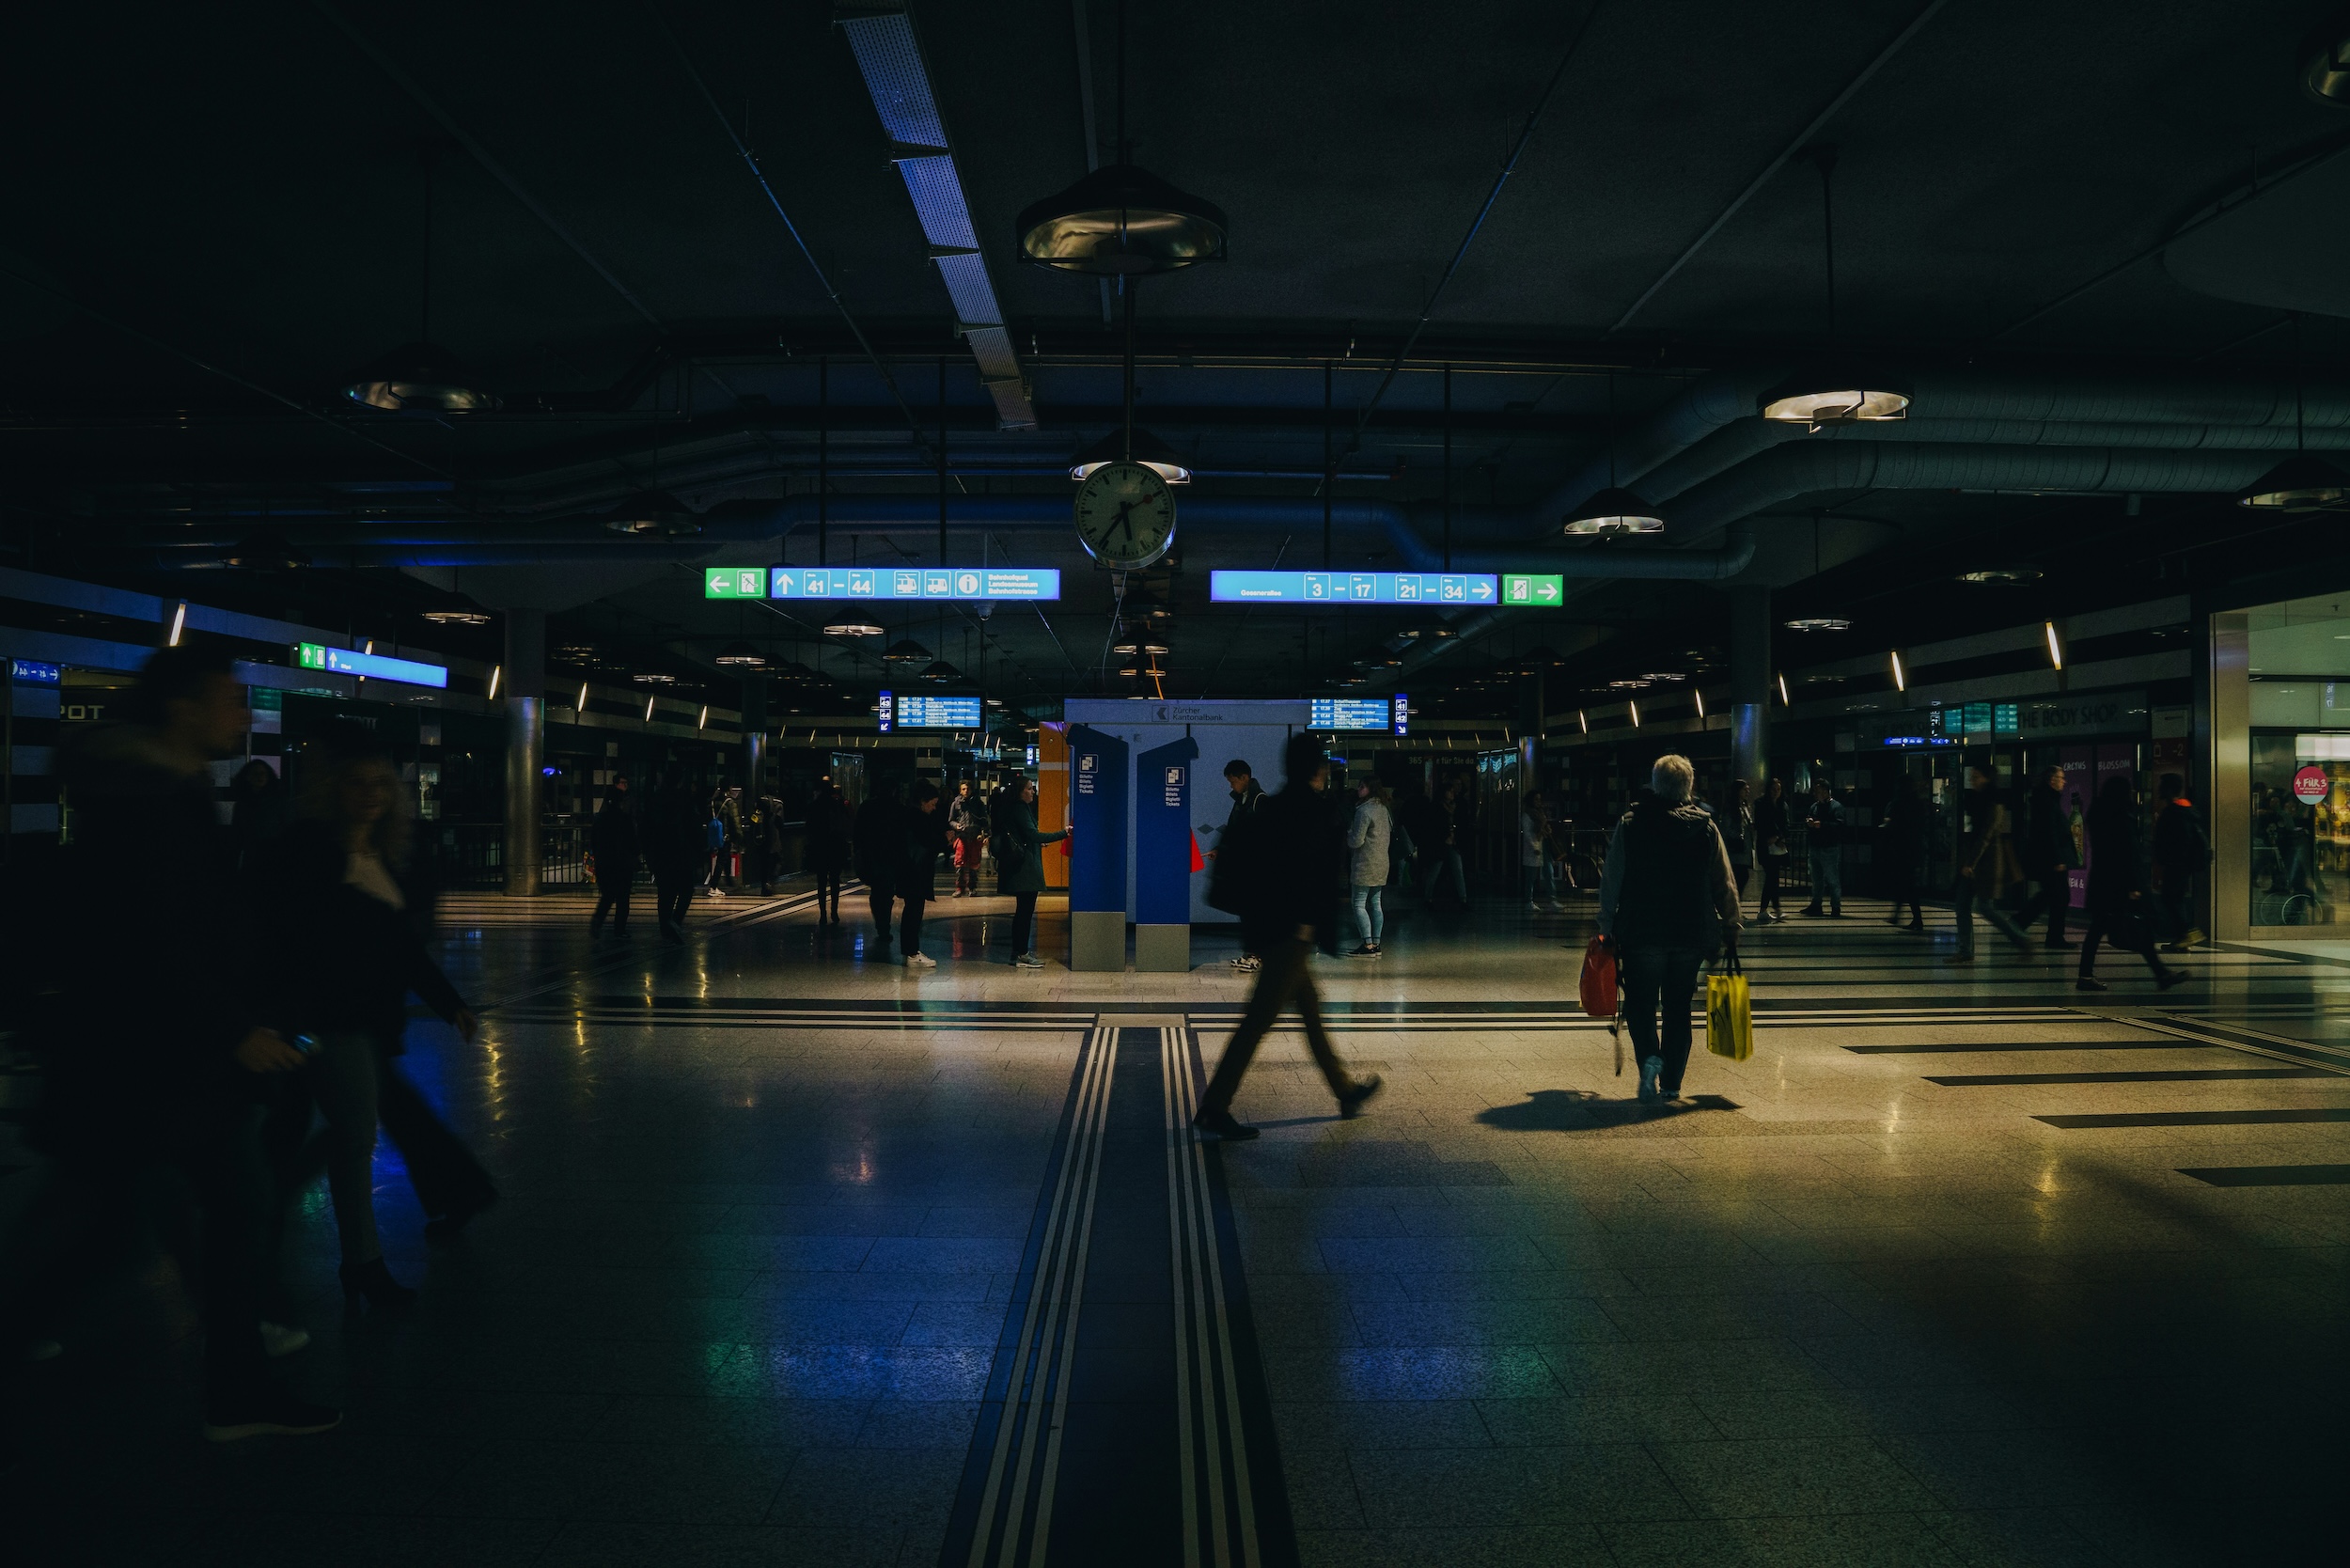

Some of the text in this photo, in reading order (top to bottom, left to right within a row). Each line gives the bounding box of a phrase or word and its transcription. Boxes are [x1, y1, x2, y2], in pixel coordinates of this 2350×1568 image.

[807, 580, 823, 593] 41
[852, 580, 871, 593] 44
[1312, 583, 1323, 597] 3
[1355, 584, 1371, 597] 17
[1400, 585, 1417, 598] 21
[1444, 586, 1463, 599] 34
[2016, 711, 2039, 729] THE
[2042, 707, 2078, 728] BODY
[1408, 756, 1422, 765] 365
[1441, 756, 1452, 765] für
[1453, 756, 1465, 765] Sie
[2063, 759, 2131, 771] CACTUS BLOSSOM
[2295, 776, 2327, 788] 4 FÜR 3
